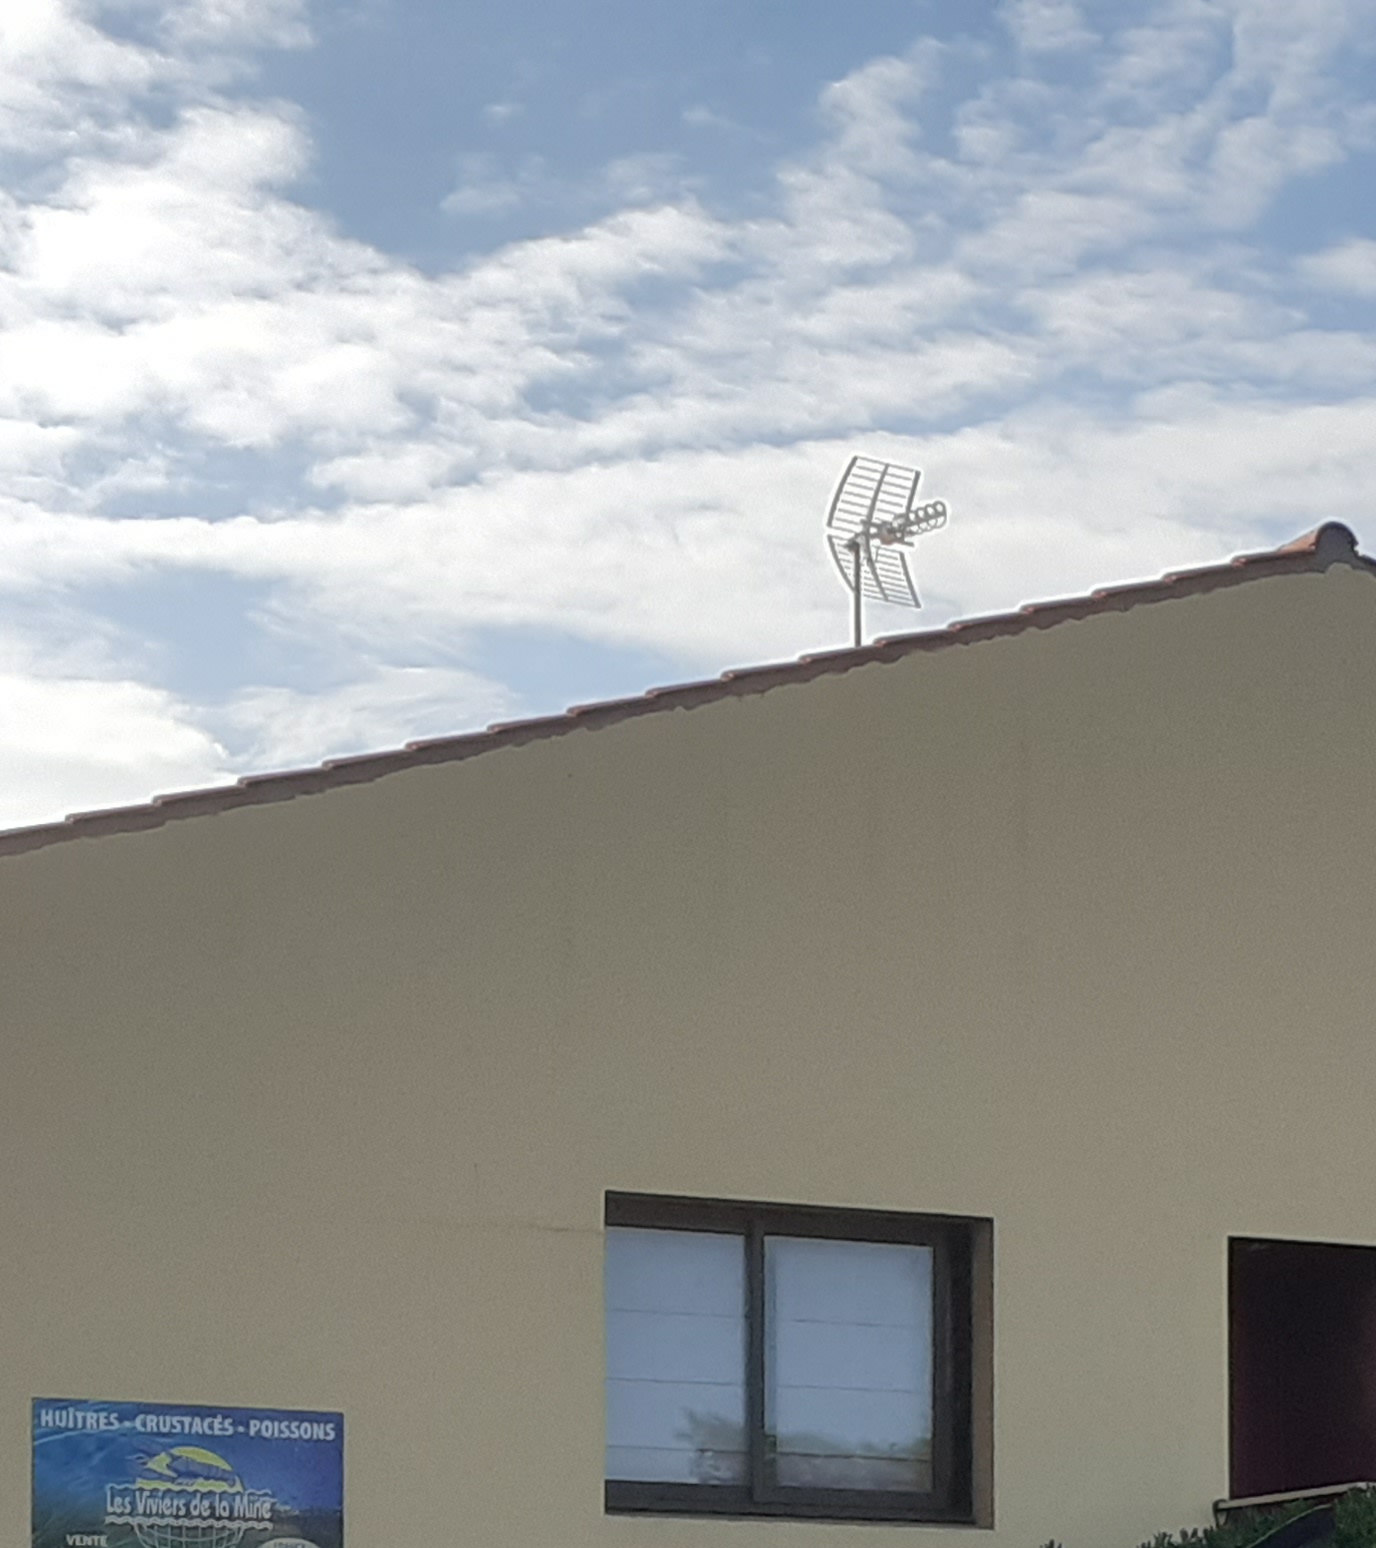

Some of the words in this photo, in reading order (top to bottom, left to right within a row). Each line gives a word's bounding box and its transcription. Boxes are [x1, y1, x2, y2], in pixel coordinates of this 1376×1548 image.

[40, 1407, 119, 1430] HUÎTRES
[249, 1419, 335, 1441] POISSONS
[106, 1490, 131, 1514] Les
[135, 1490, 186, 1516] Viviers
[190, 1492, 211, 1517] de
[215, 1493, 229, 1517] la
[234, 1494, 272, 1519] Mine
[65, 1534, 108, 1547] VENTE
